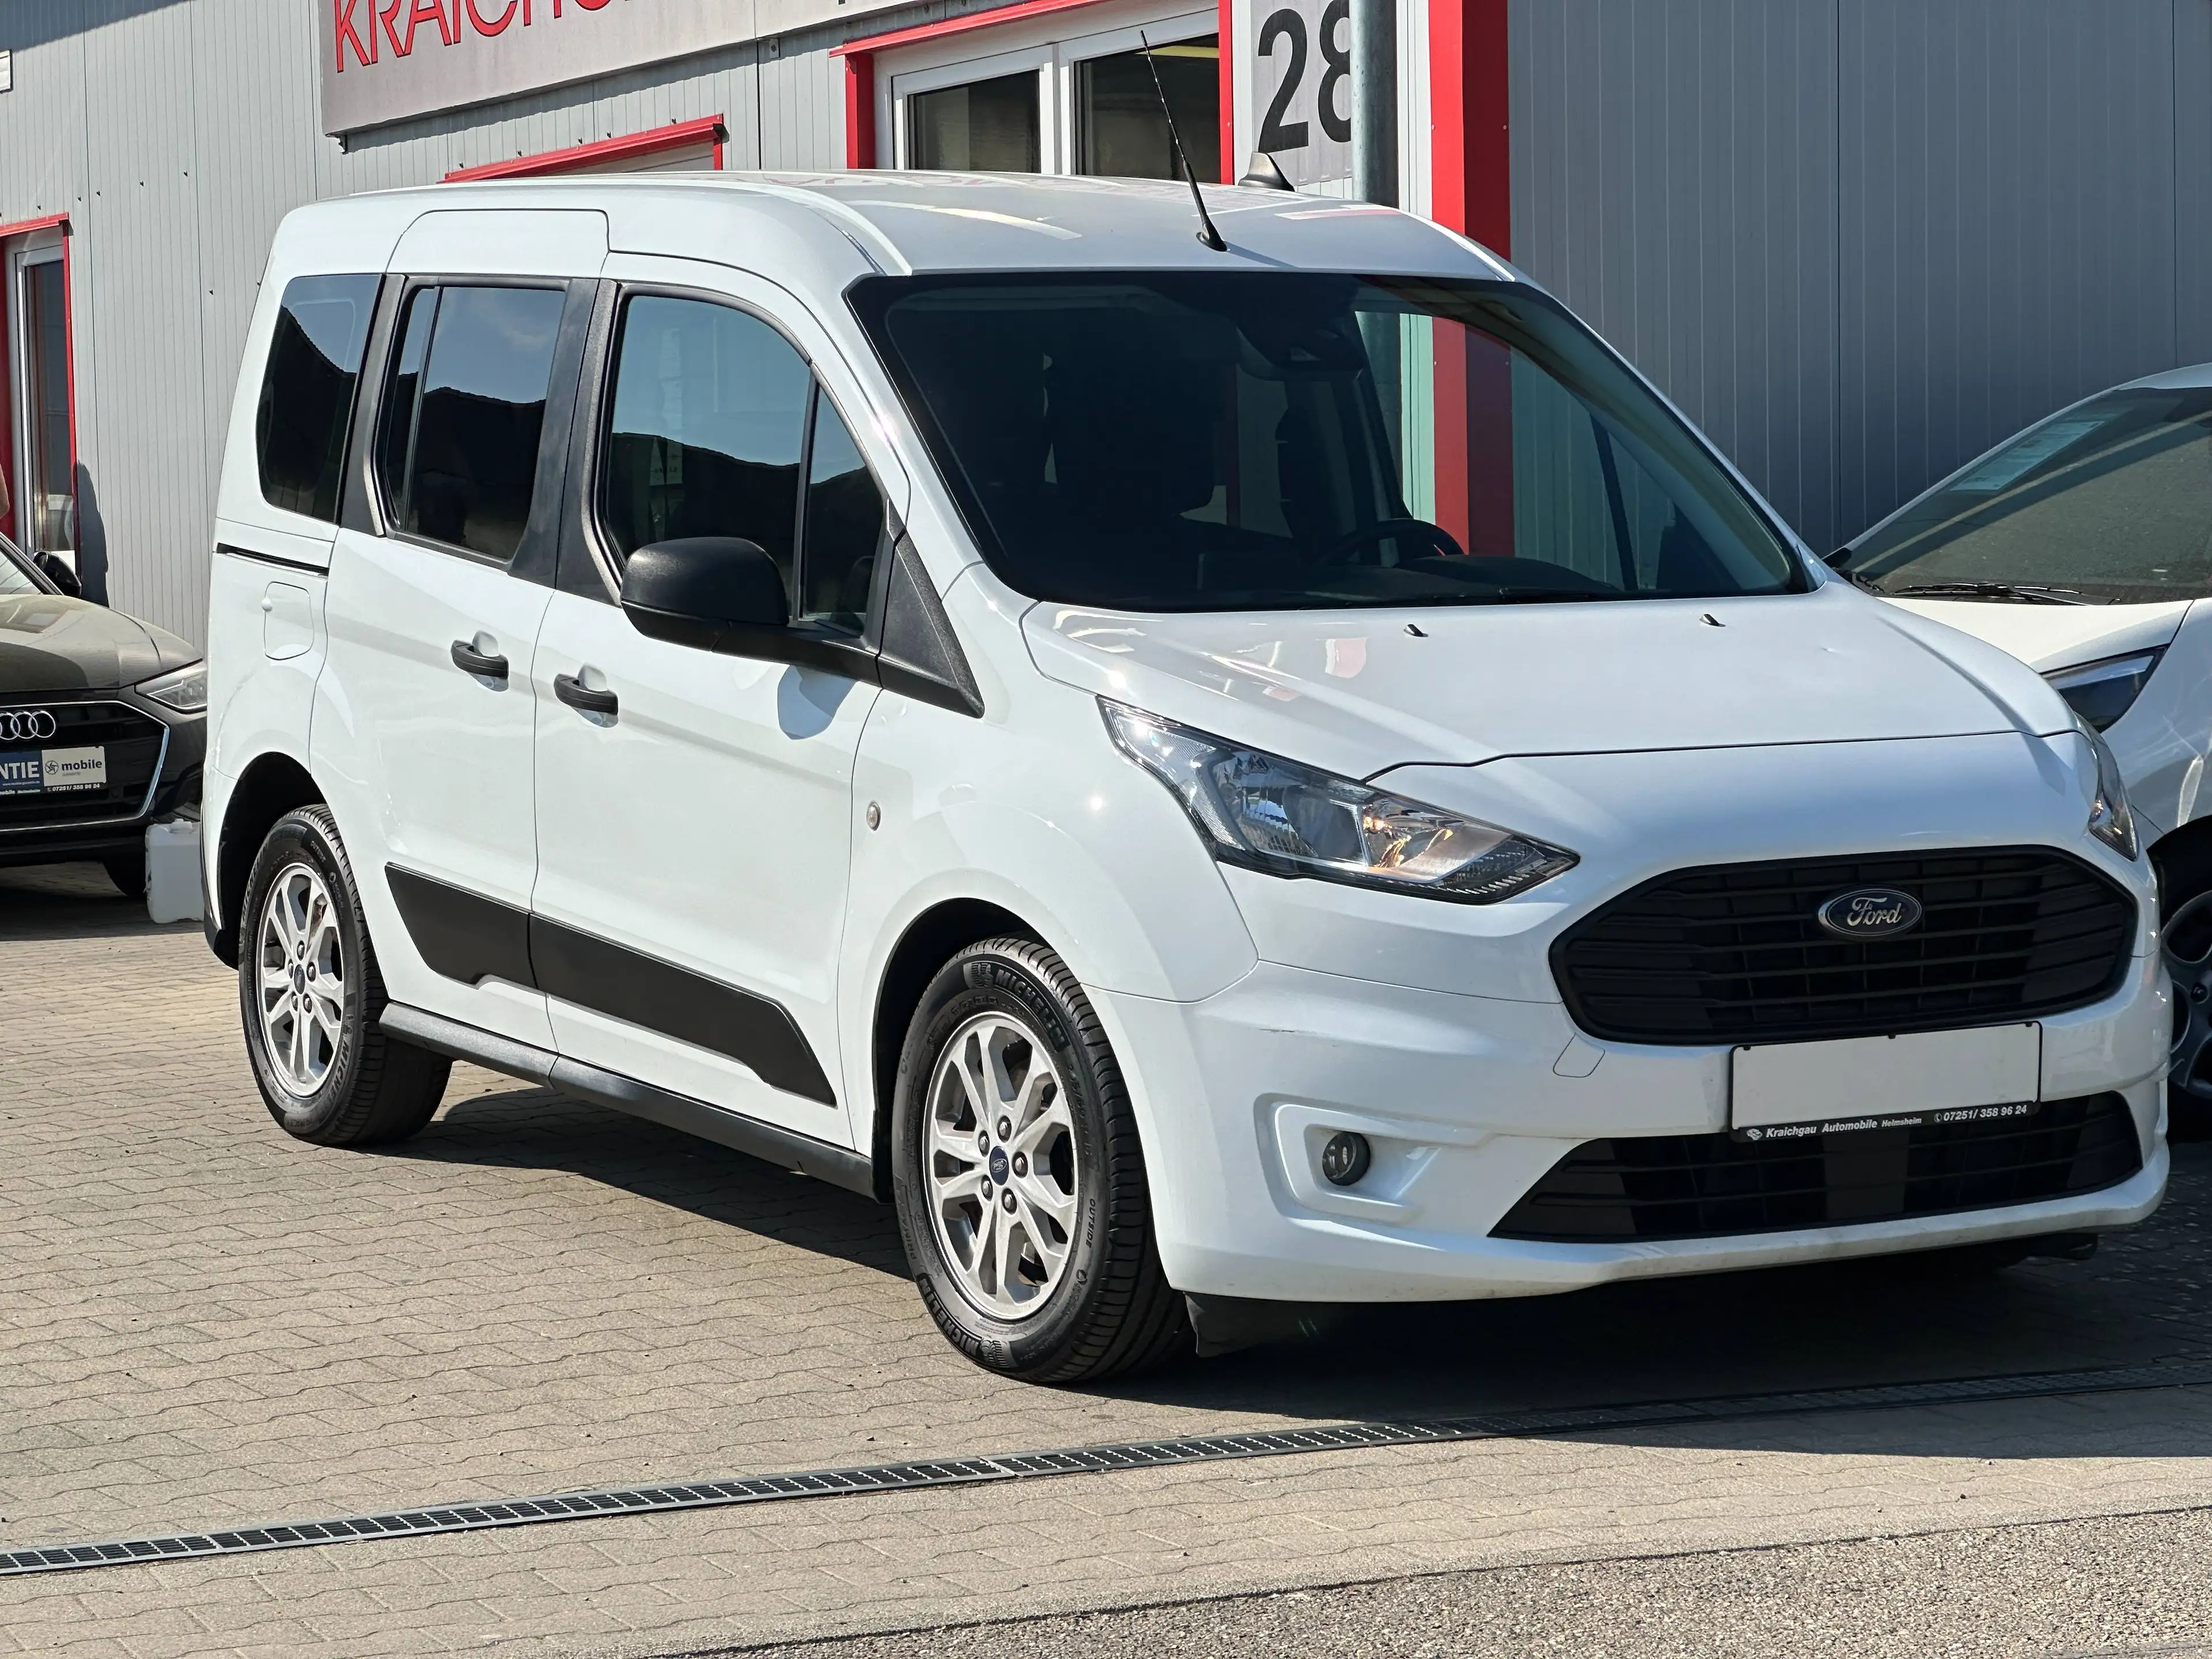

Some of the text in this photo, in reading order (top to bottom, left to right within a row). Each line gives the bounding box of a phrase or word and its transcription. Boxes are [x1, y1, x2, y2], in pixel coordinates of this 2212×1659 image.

[1258, 0, 1351, 153] 28
[61, 759, 103, 771] mobile
[1847, 897, 1902, 926] Ford
[994, 968, 1068, 1045] MICHELIN
[1766, 1104, 2028, 1138] Kraichgau Automobile Helmsheim 07251/ 358 96 24
[1085, 1198, 1096, 1249] OUTSIDE
[919, 1276, 979, 1353] MICHELIN
